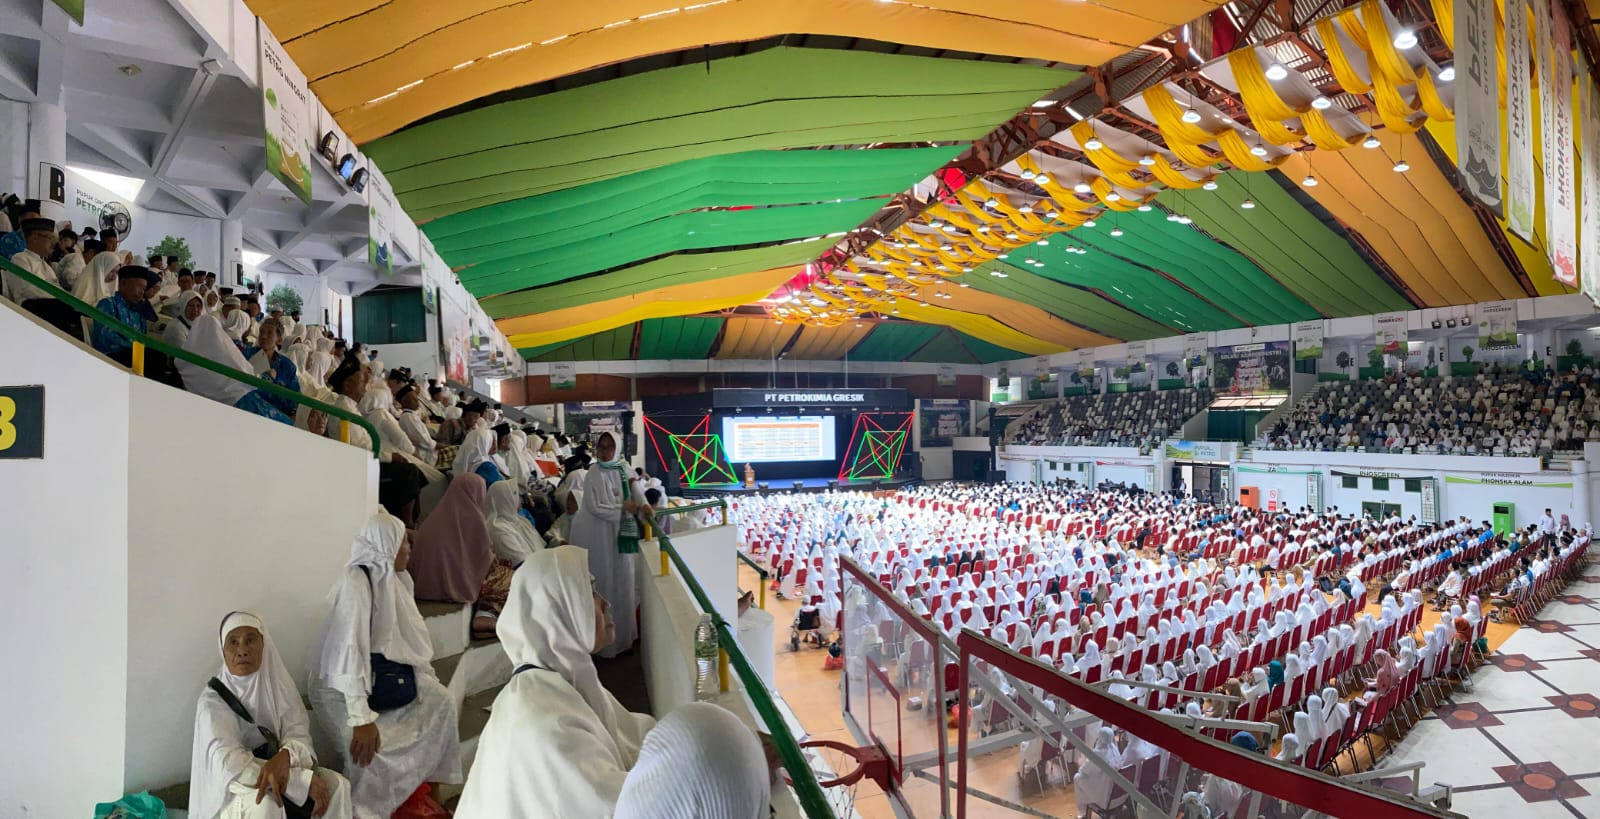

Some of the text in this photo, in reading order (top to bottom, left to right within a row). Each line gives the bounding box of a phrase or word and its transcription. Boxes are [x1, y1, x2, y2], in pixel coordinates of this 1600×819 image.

[264, 48, 284, 78] PETRO
[49, 166, 65, 204] B
[764, 393, 865, 402] PT PETROKIMIA GRESIK
[1481, 478, 1512, 486] PHONSKA
